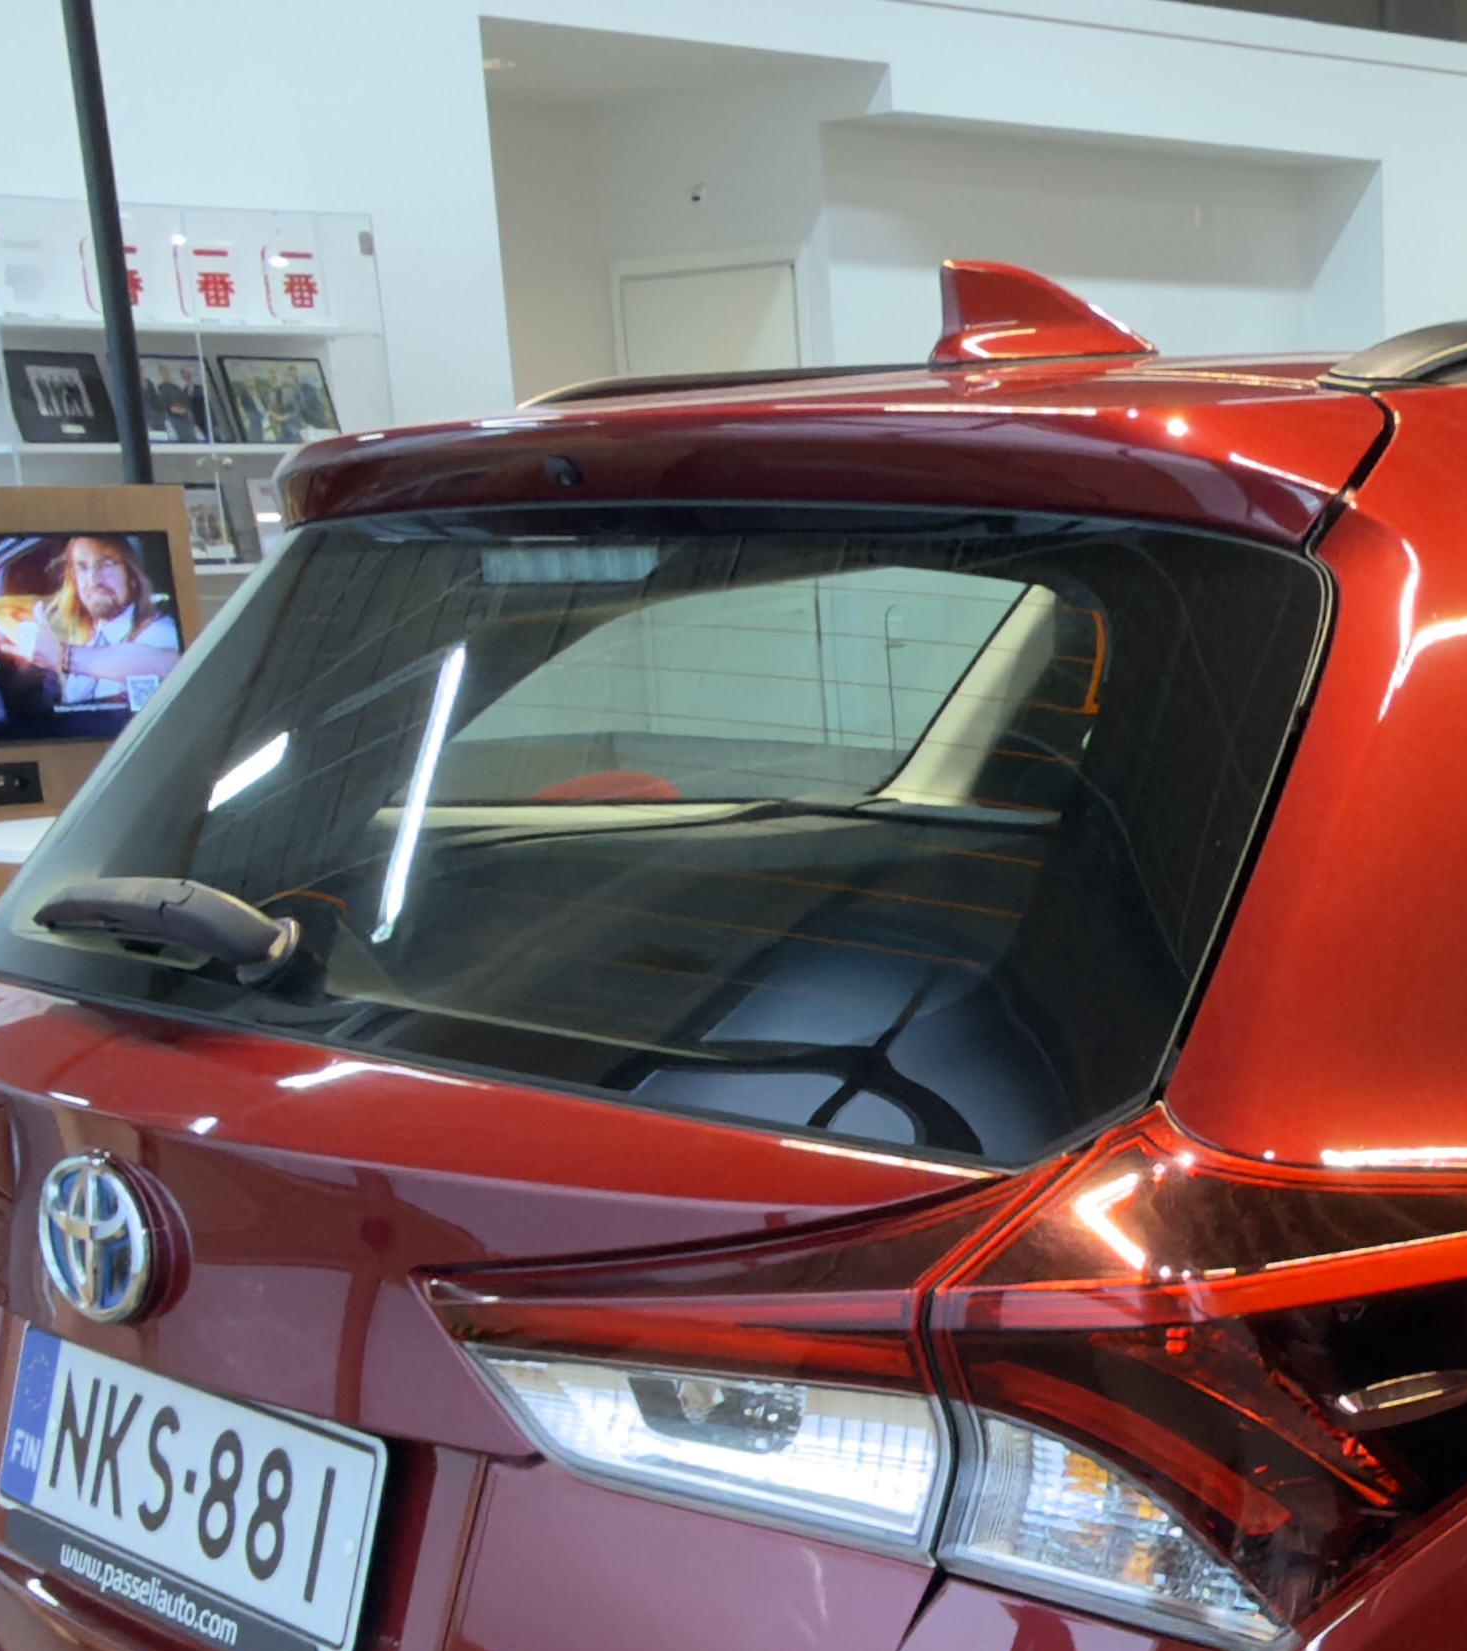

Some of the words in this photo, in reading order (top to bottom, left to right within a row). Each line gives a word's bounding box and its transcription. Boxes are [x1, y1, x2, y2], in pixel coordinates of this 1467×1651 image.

[10, 1430, 42, 1473] FIN
[48, 1370, 336, 1603] NKS-881
[59, 1543, 239, 1648] www.passeliauto.com
